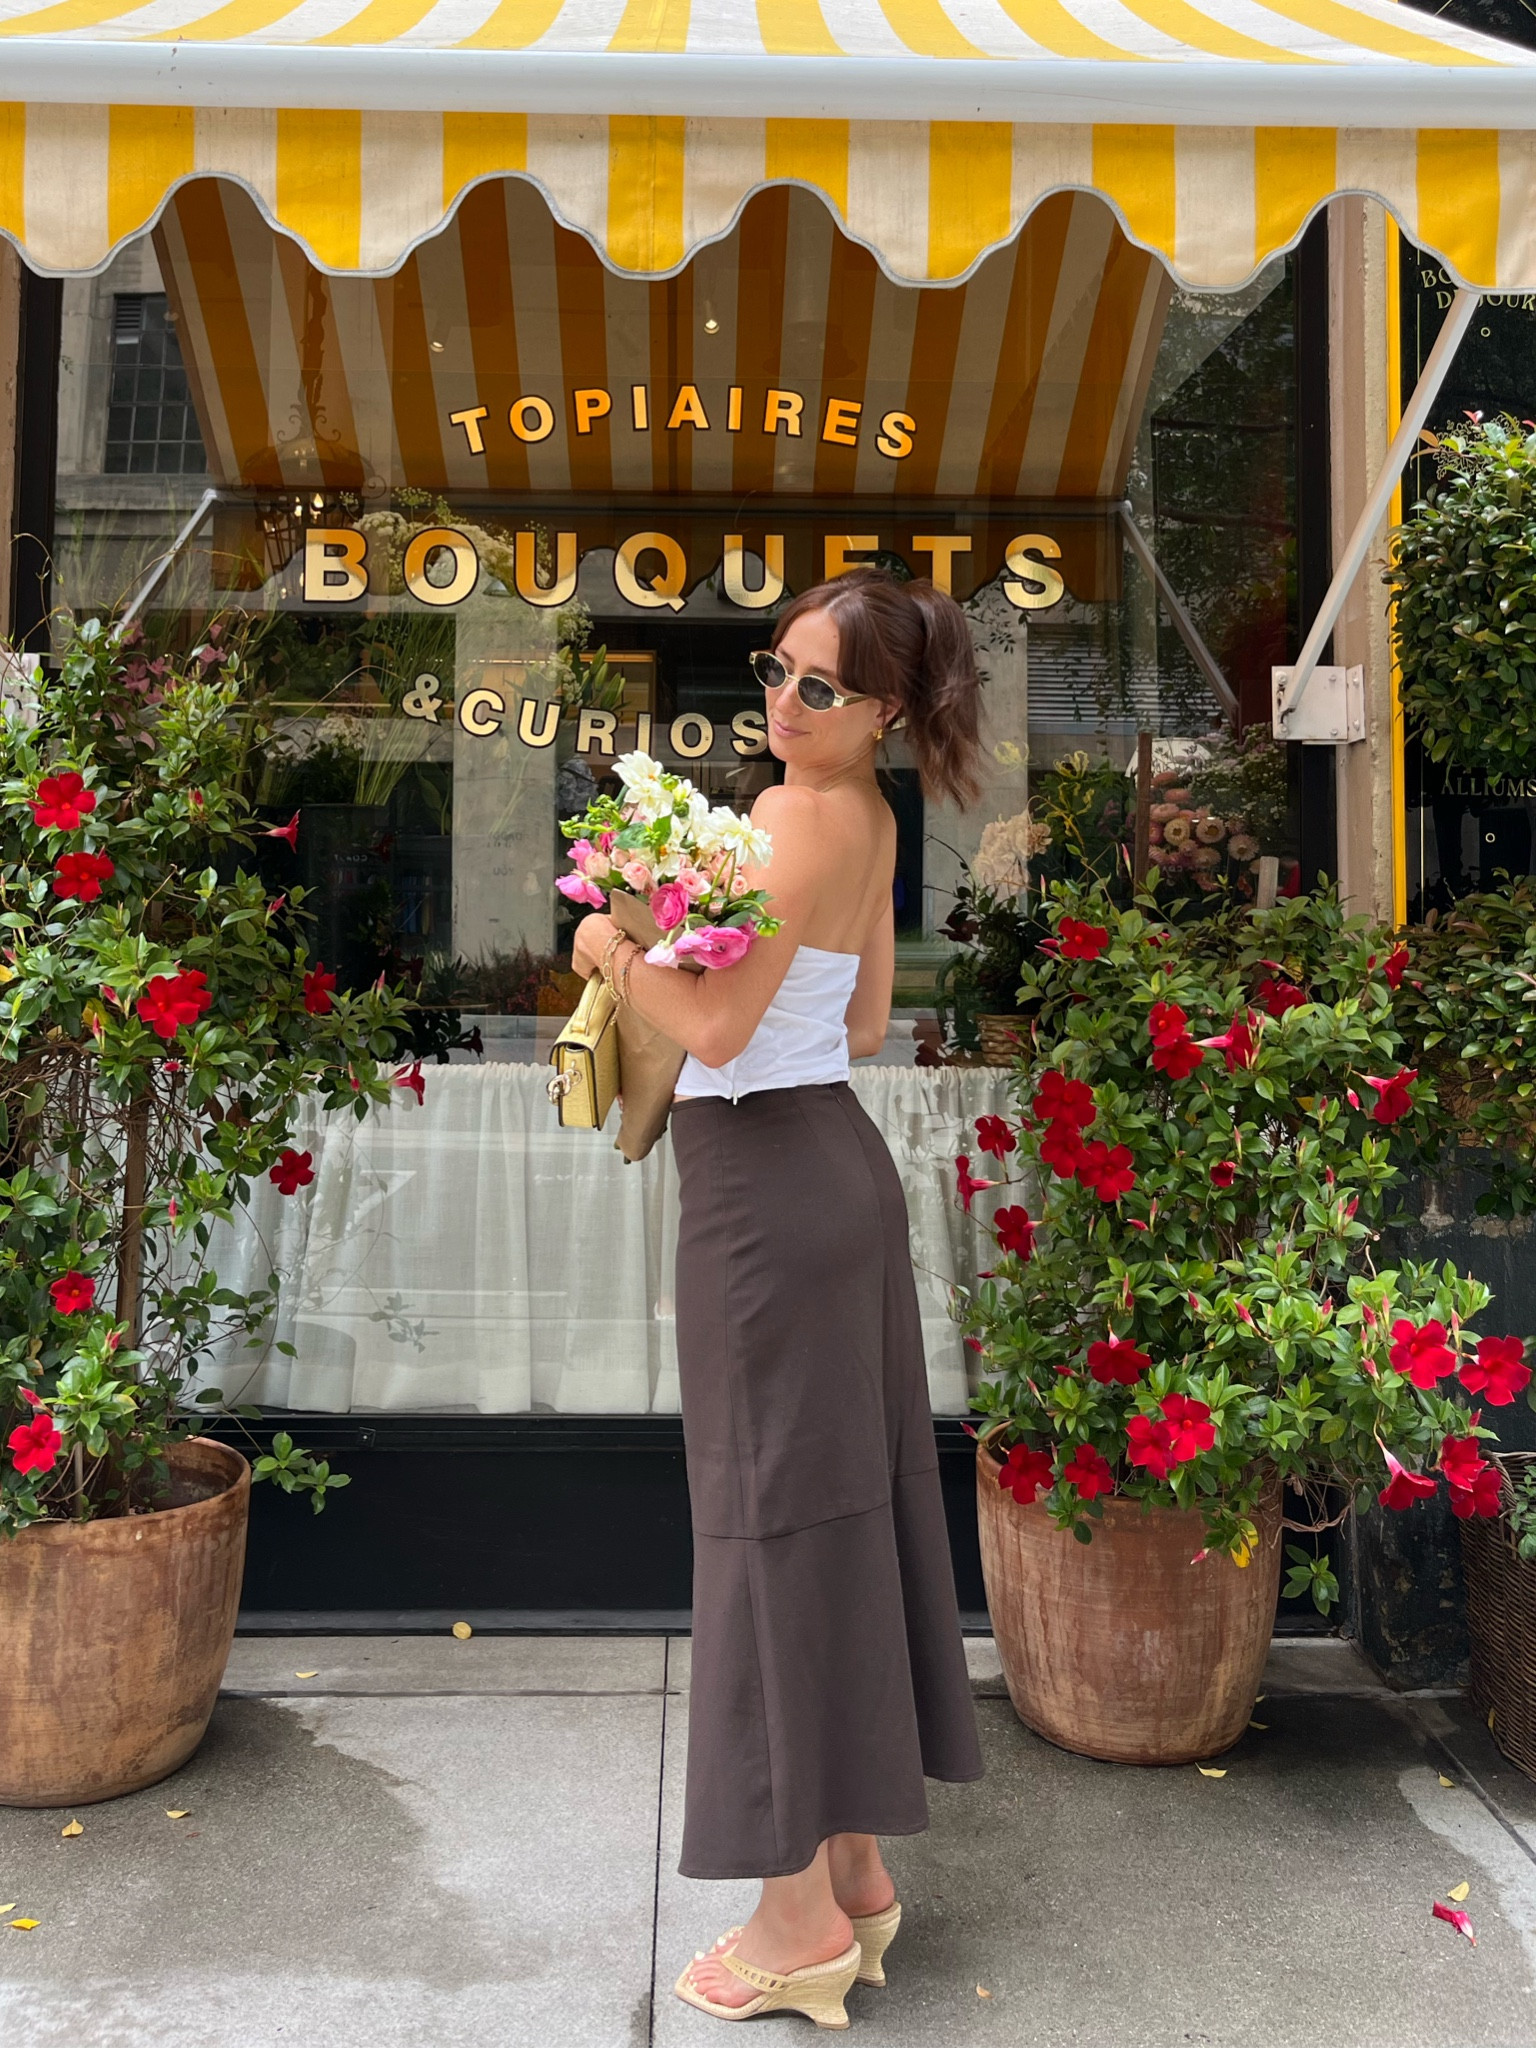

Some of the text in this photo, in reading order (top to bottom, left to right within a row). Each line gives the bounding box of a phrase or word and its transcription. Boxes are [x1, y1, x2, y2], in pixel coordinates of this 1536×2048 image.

[1436, 289, 1460, 309] D
[449, 384, 917, 459] TOPIAIRES
[303, 527, 1067, 613] BOUQUETS
[459, 687, 768, 759] CURIOS
[1440, 776, 1536, 797] ALLIUMS
